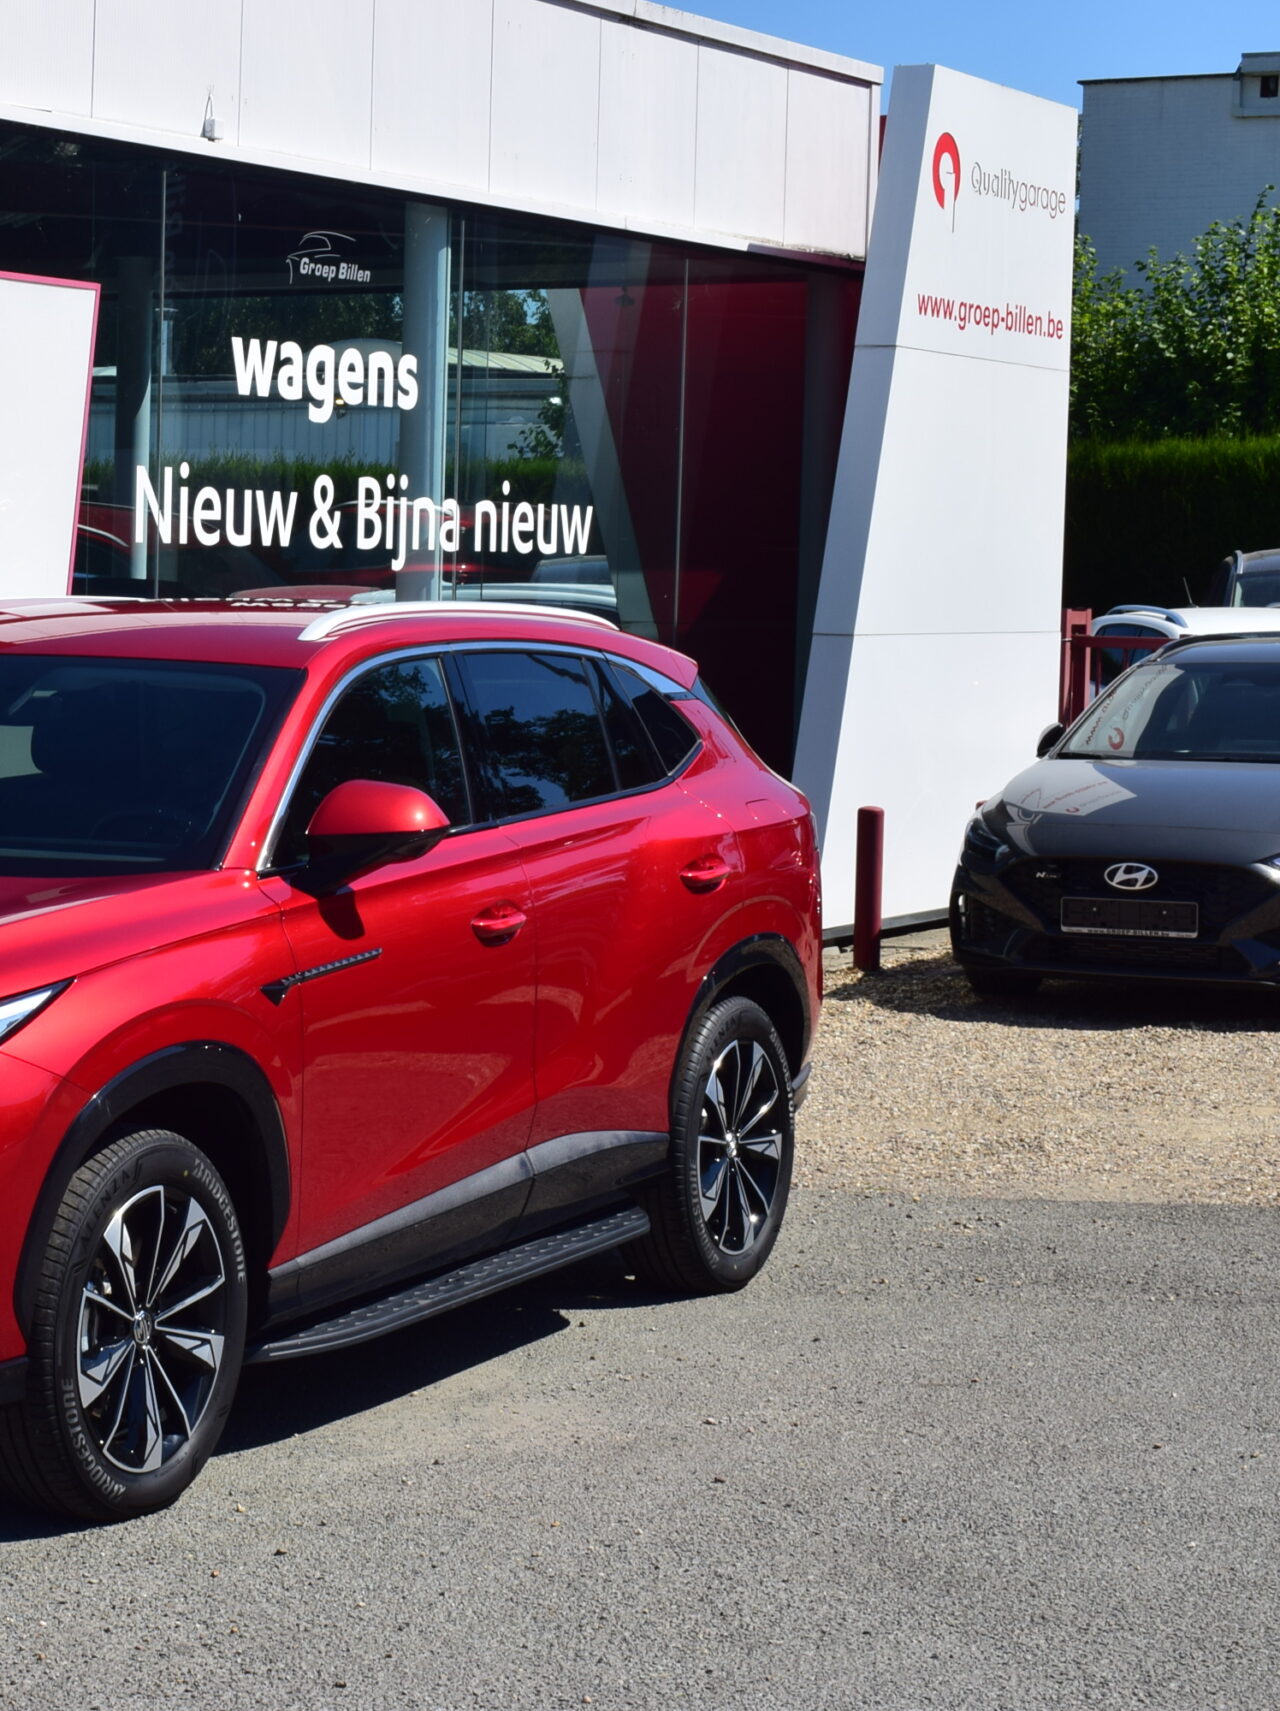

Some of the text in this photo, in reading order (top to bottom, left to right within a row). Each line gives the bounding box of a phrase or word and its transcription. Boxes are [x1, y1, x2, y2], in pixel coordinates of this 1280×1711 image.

[971, 161, 1066, 220] Qualitygarage
[299, 257, 371, 283] Groep Billen
[918, 293, 1063, 340] www.groep-billen.be
[231, 336, 418, 423] wagens
[135, 462, 593, 571] Nieuw & Bijna nieuw
[191, 1158, 248, 1284] BRIDGESTONE
[61, 1377, 127, 1505] BRIDGESTONE
